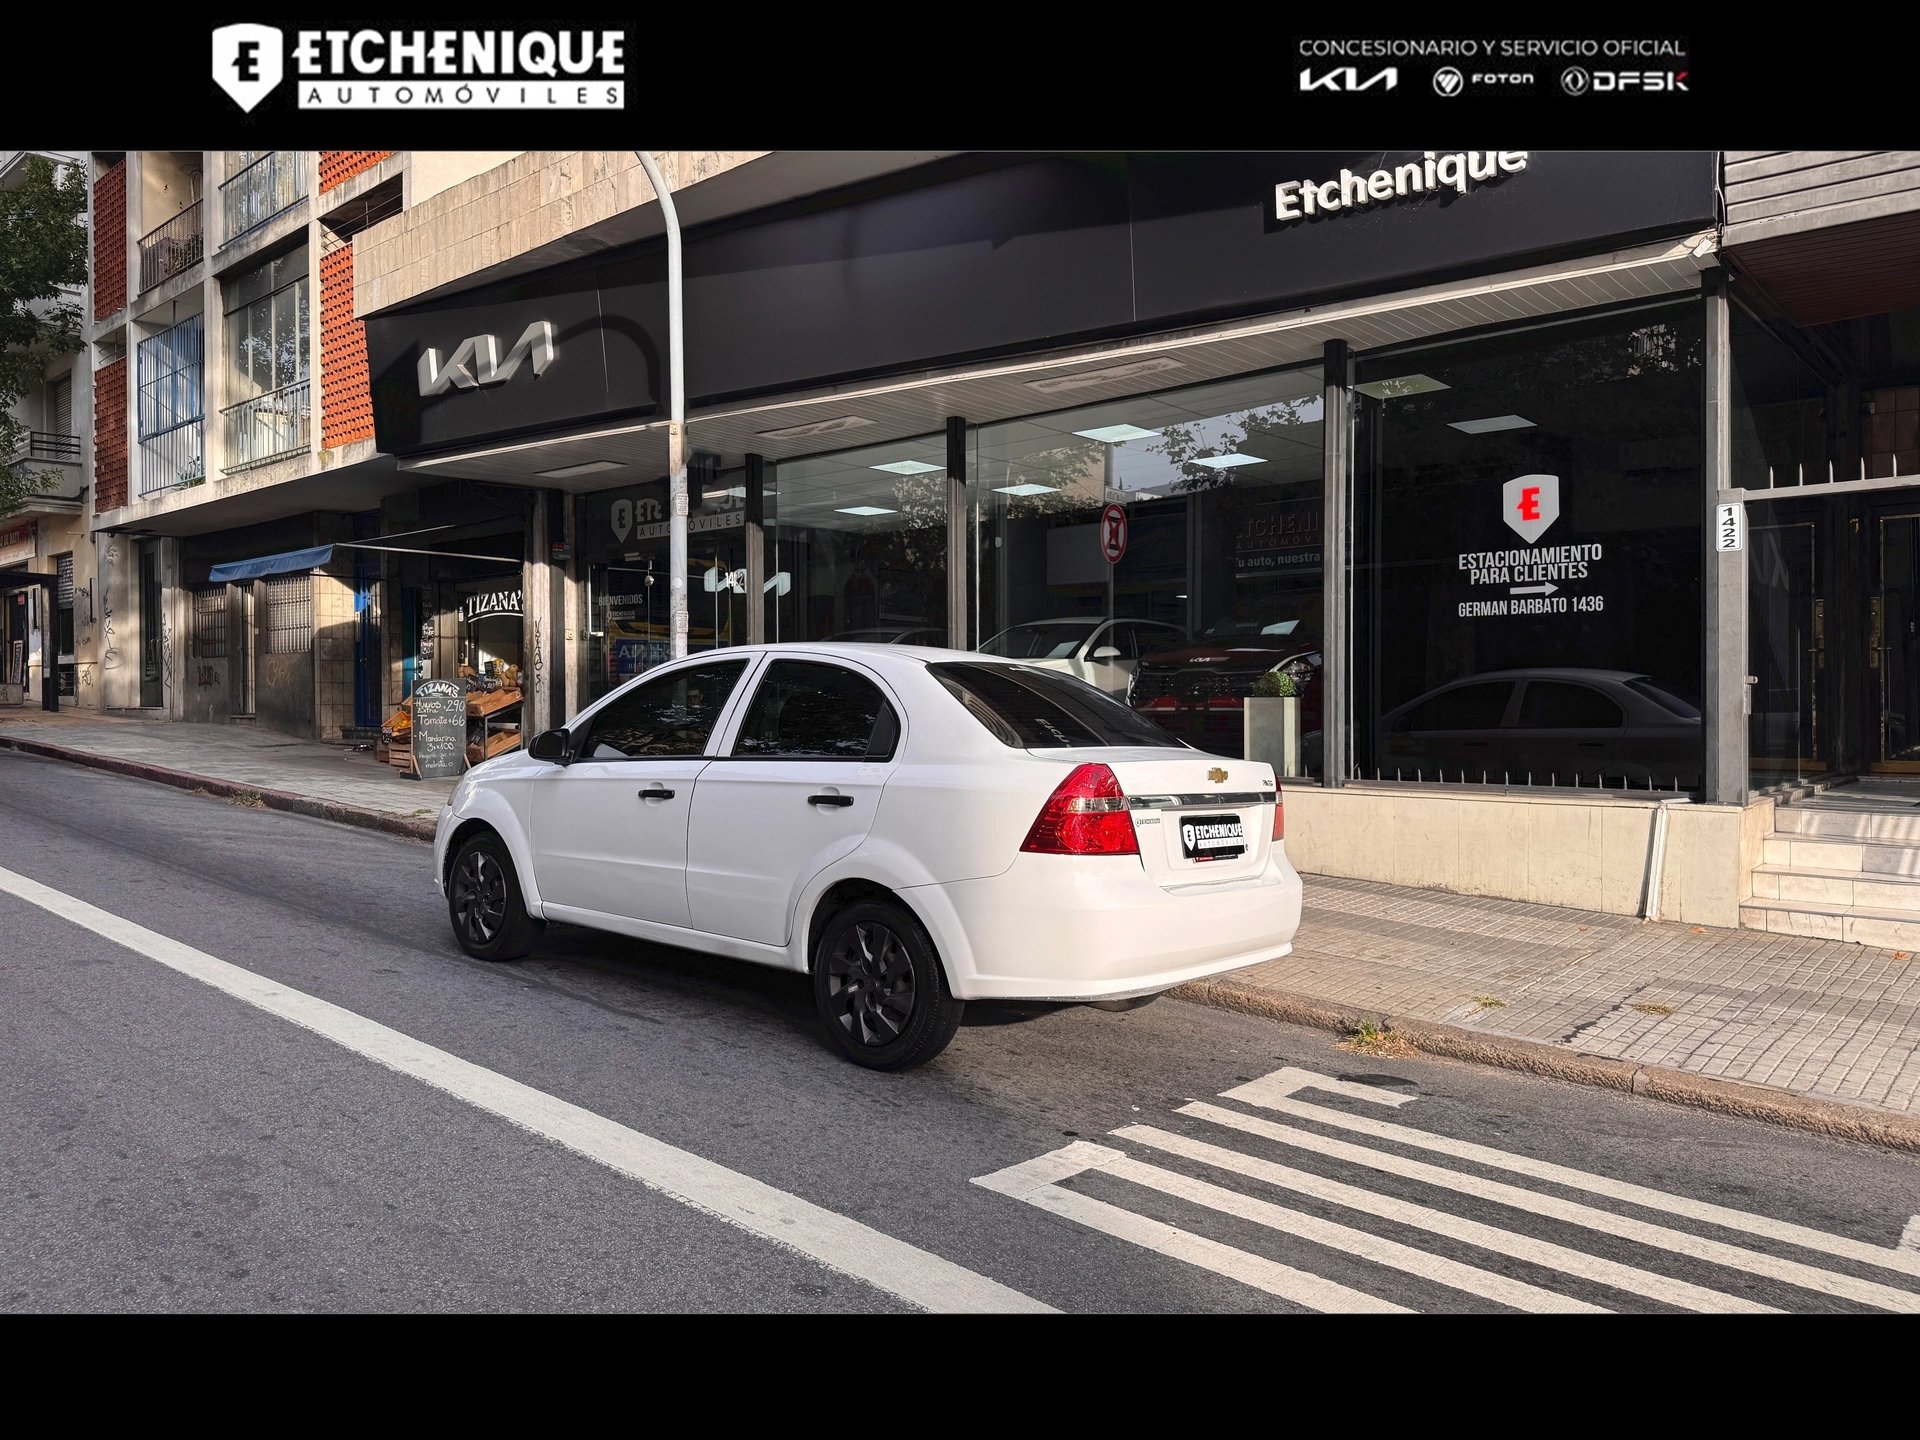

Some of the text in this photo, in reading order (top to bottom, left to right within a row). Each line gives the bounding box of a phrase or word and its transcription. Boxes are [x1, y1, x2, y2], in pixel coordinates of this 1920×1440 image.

[1274, 151, 1529, 221] Etchenique
[416, 320, 555, 397] KIA
[1721, 507, 1737, 549] 1422
[1247, 555, 1275, 567] auto,
[1277, 551, 1321, 565] nuestra
[1458, 543, 1603, 570] ESTACIONAMIENTO
[1470, 562, 1589, 585] PARA CLIENTES
[466, 589, 524, 617] TIZANA'
[598, 594, 643, 606] BIENVENIDOS
[1458, 596, 1605, 618] GERMAN BARBATO 1436
[416, 682, 459, 698] TIZANA'S
[417, 714, 448, 726] Tomate
[418, 730, 457, 743] Mandarina
[1195, 823, 1243, 839] ETCHENIQUE
